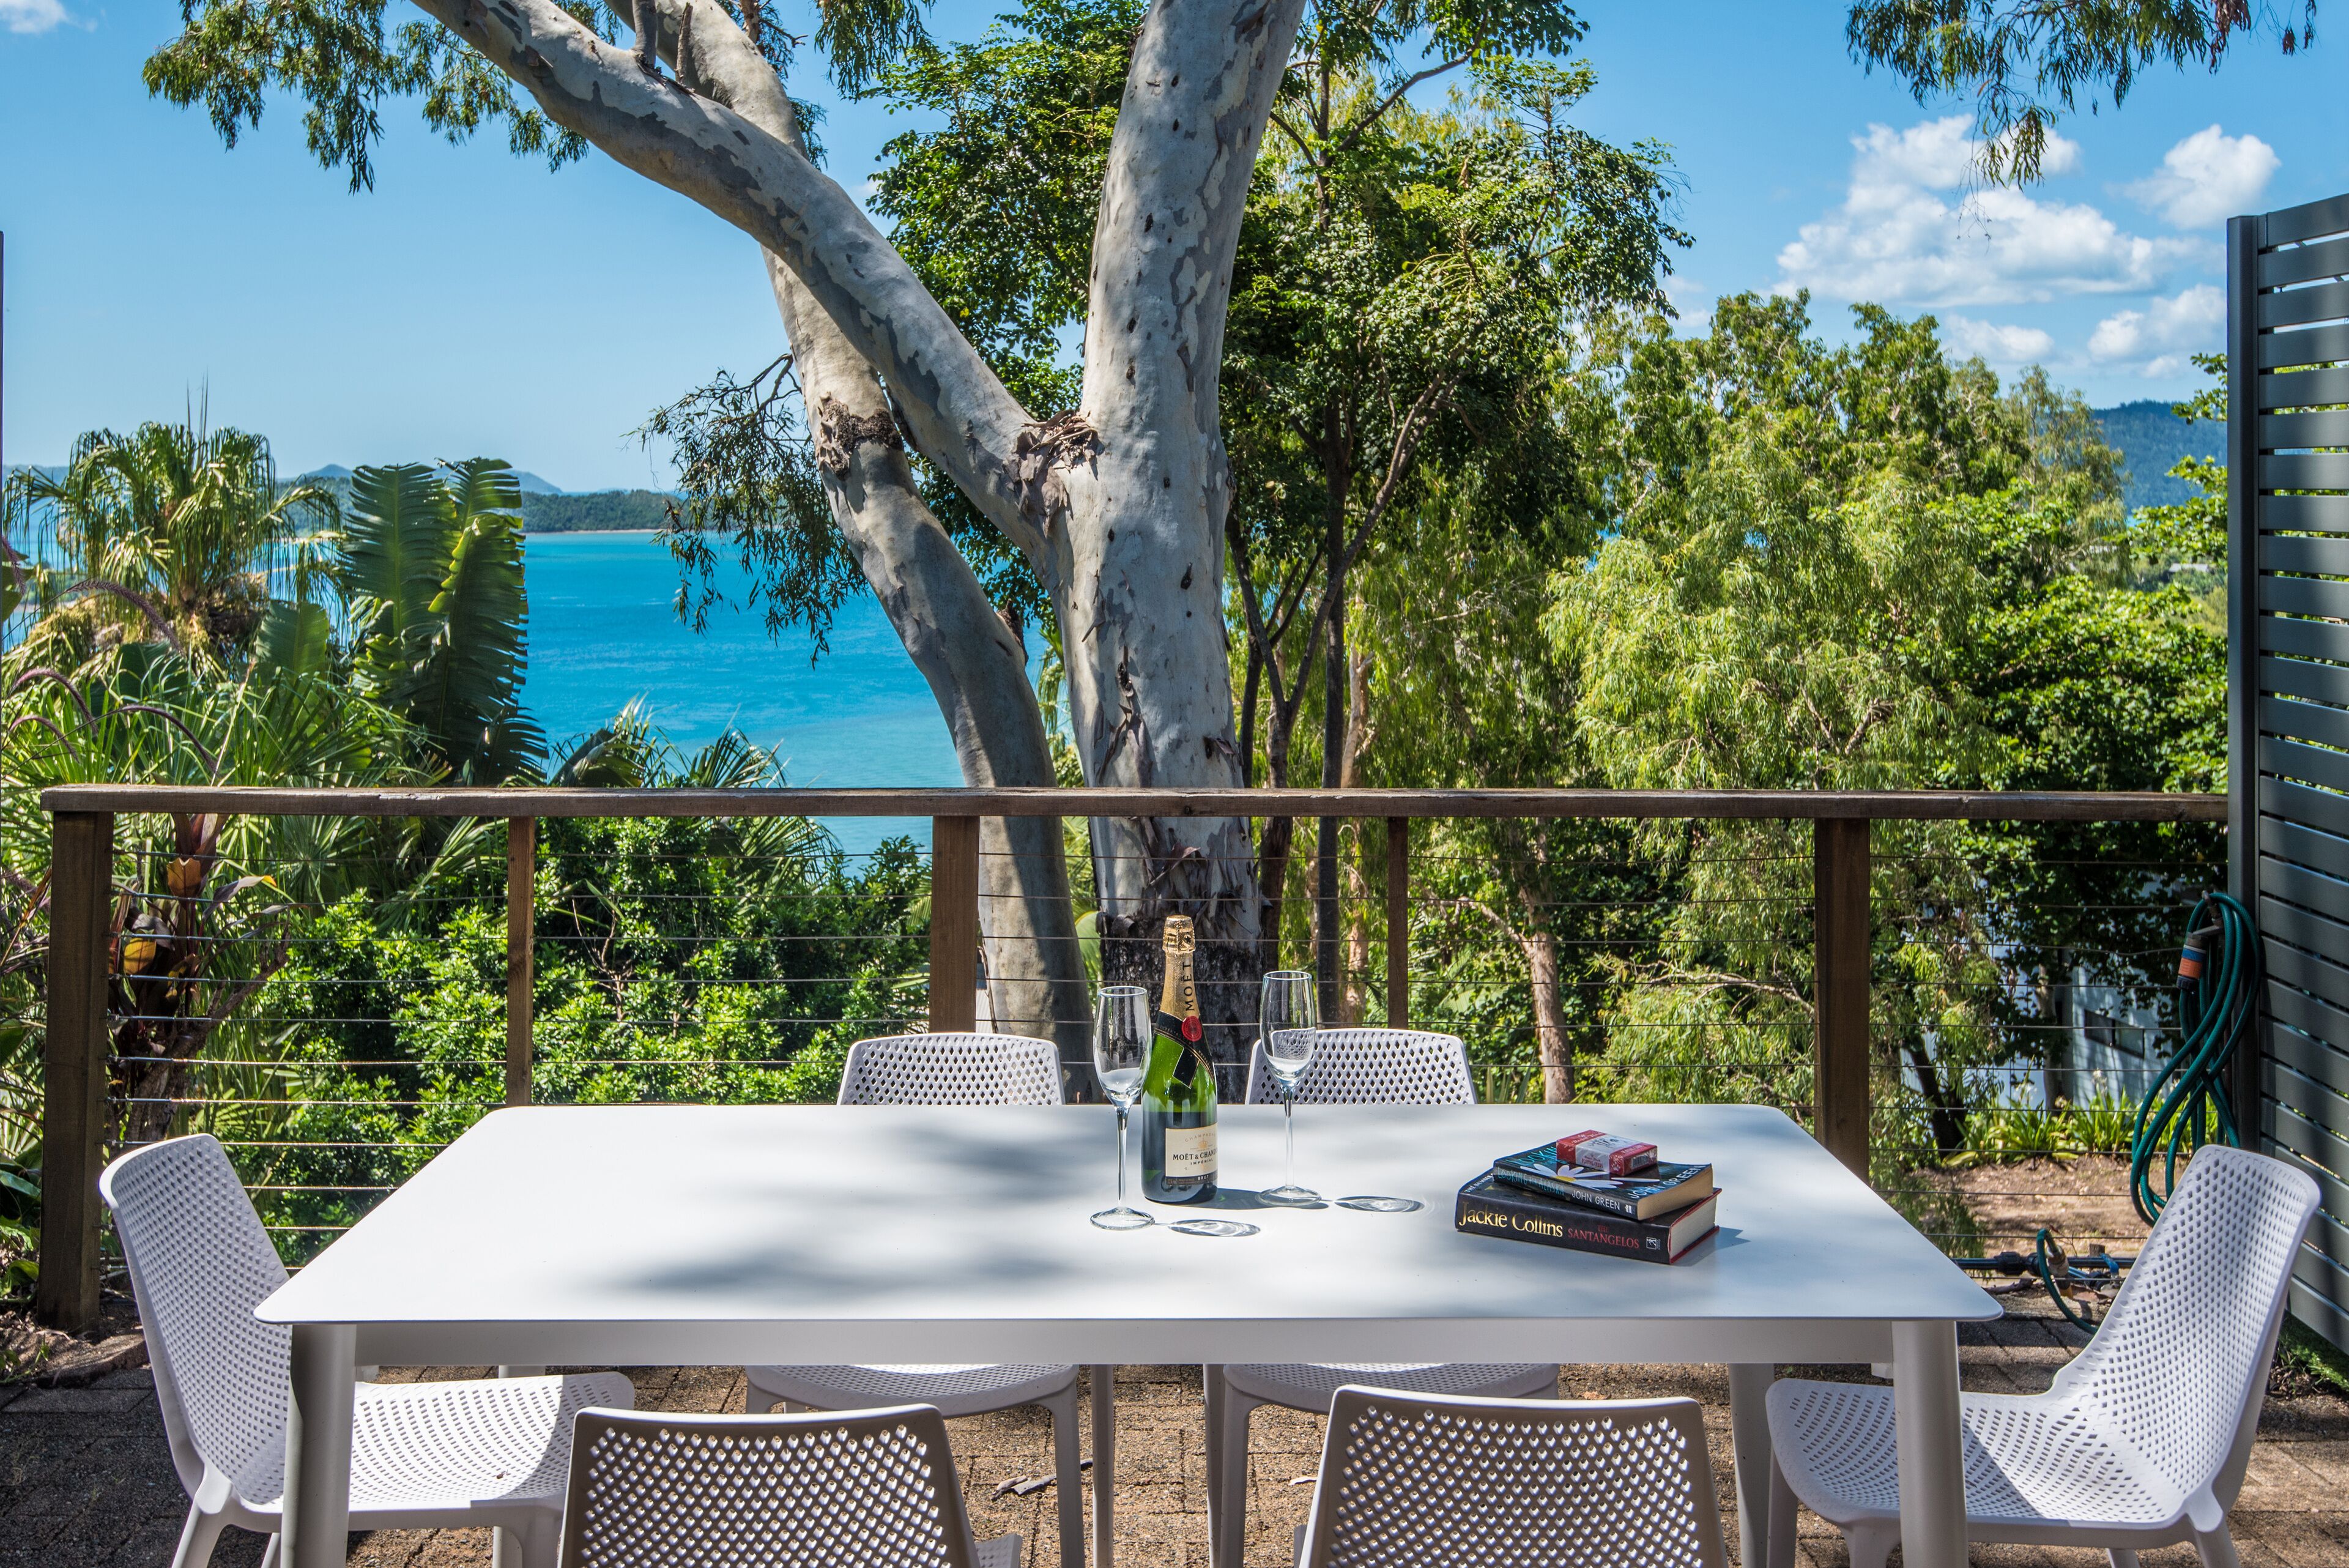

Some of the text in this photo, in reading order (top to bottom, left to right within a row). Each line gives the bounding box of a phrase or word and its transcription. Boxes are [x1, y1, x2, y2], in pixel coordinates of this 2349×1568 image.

[1182, 962, 1194, 1011] MOËT
[1505, 1146, 1557, 1166] LOOKIN
[1497, 1167, 1527, 1185] LOOKING
[1538, 1178, 1565, 1196] ALASKA
[1628, 1165, 1706, 1199] JOHN GREEN
[1572, 1190, 1620, 1210] JOHN GREEN
[1459, 1202, 1563, 1237] Jackie Collins
[1568, 1228, 1639, 1249] SANTANGELOS
